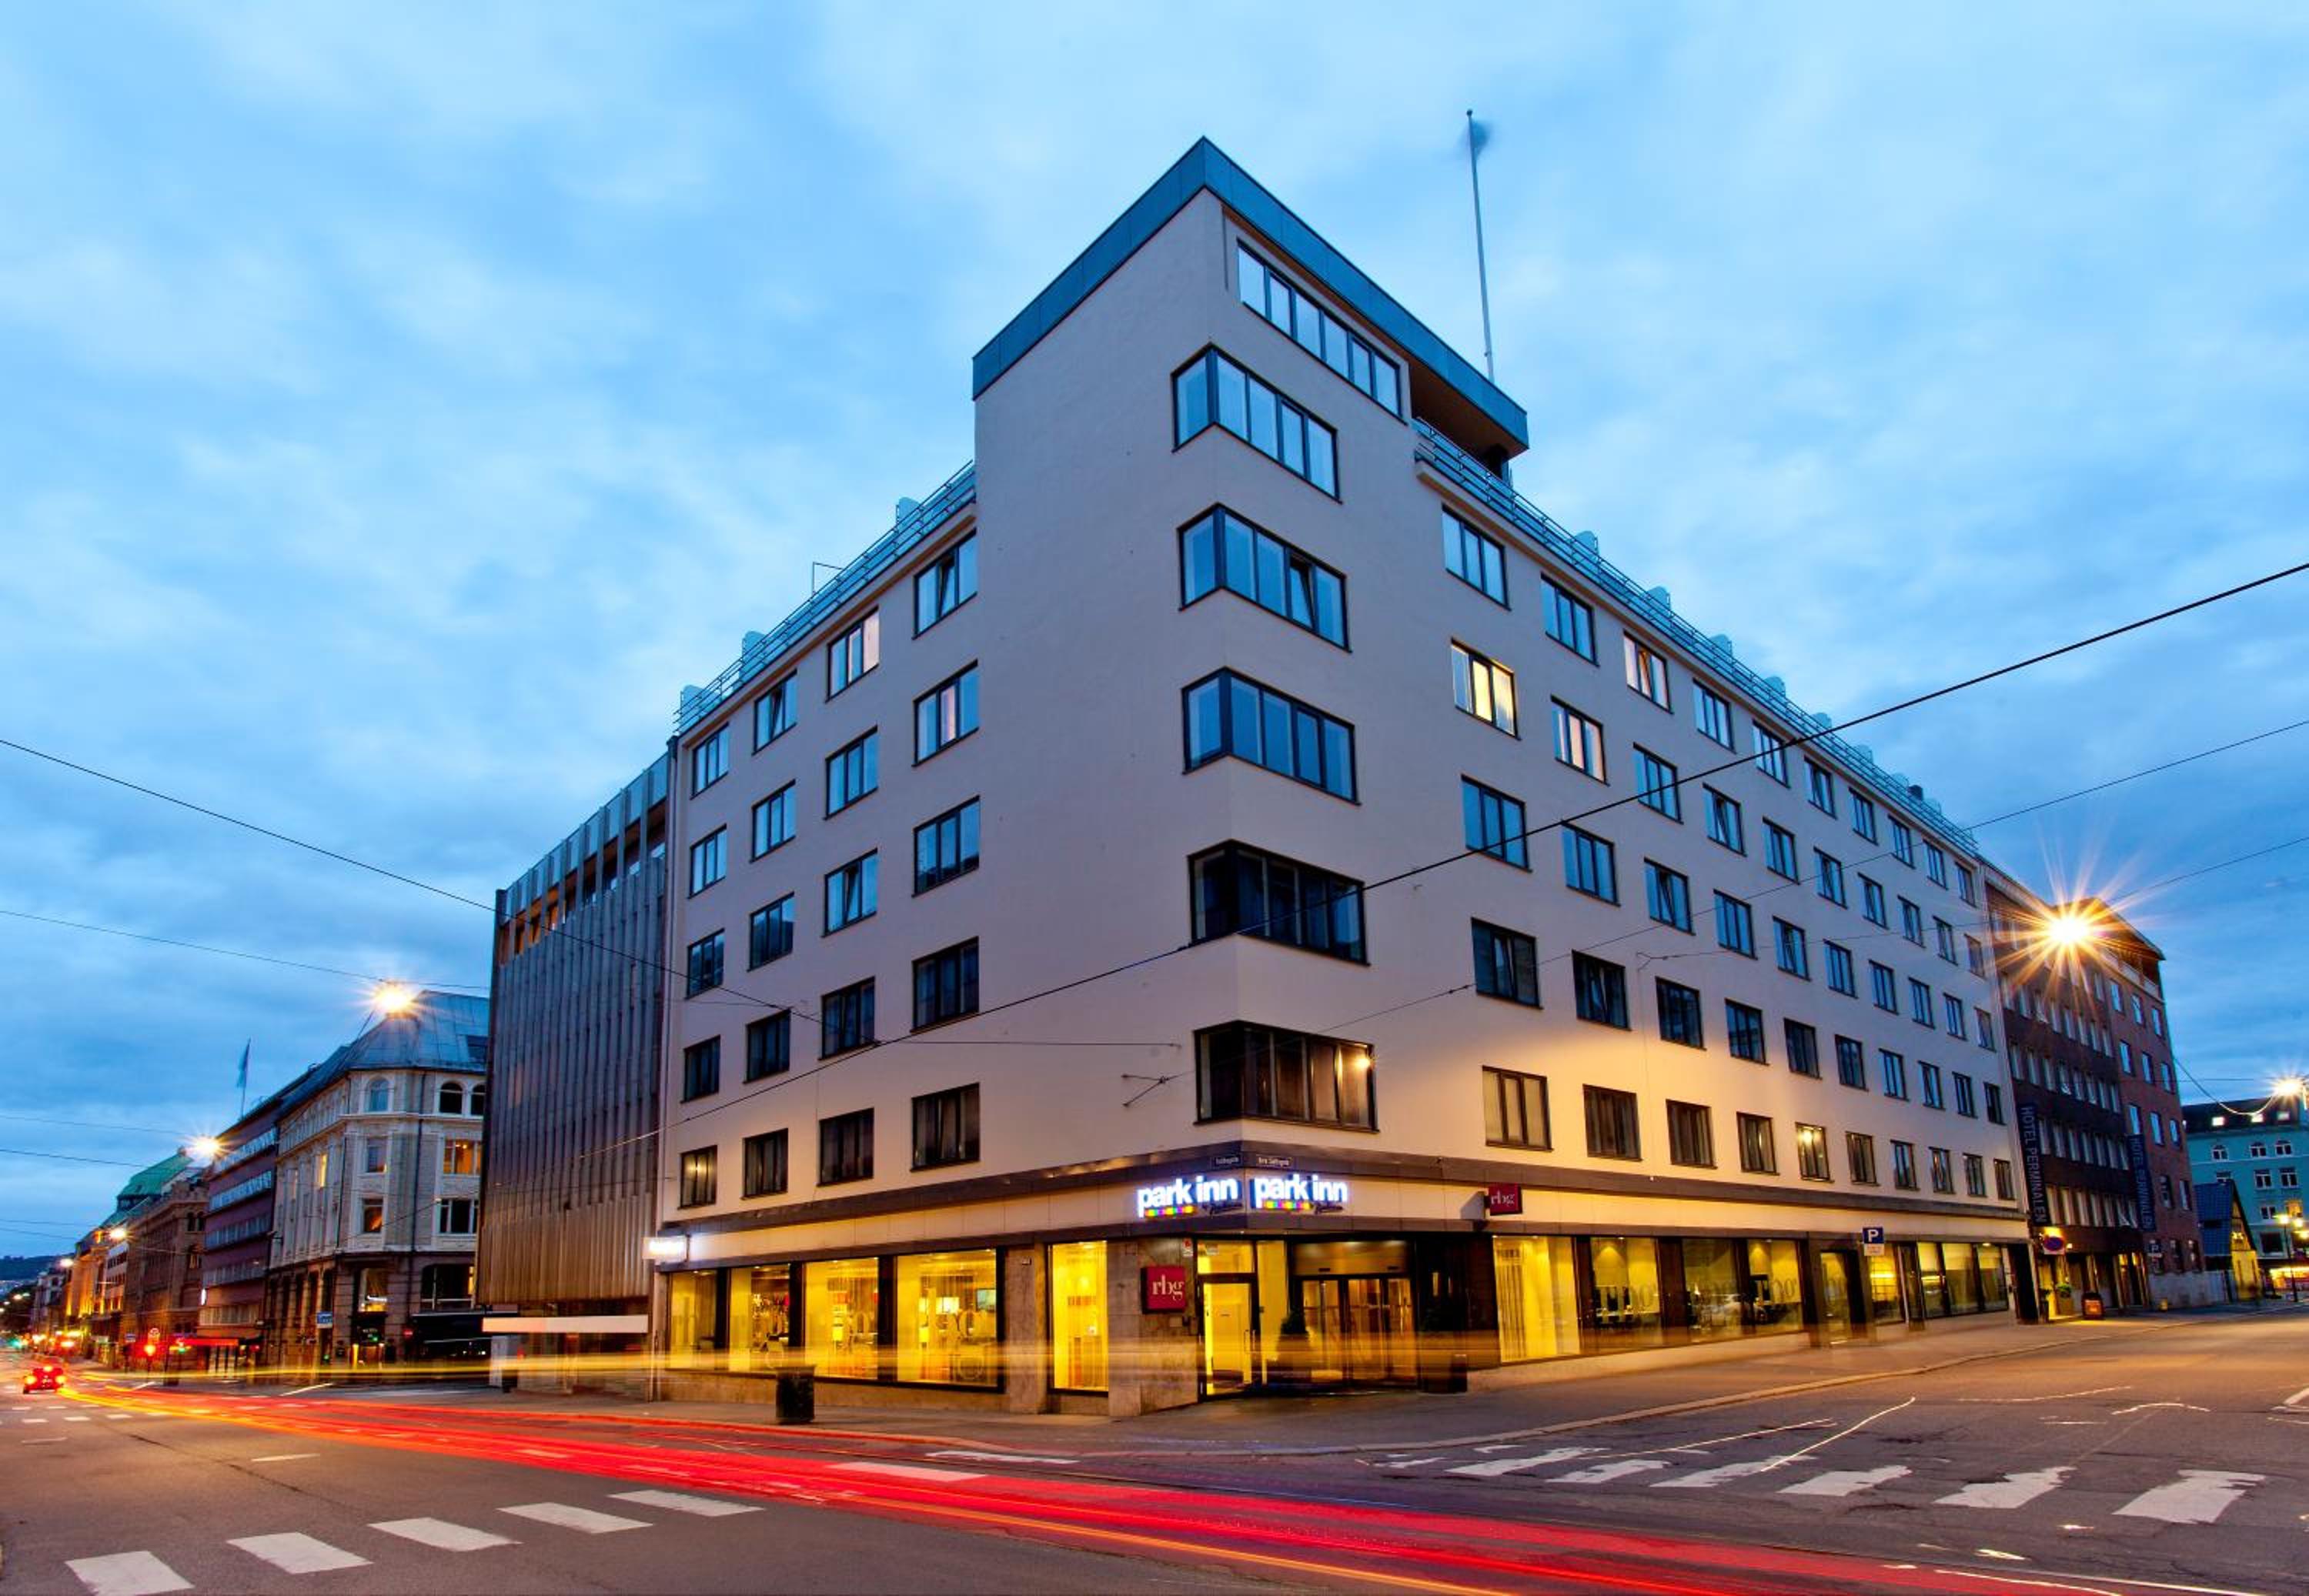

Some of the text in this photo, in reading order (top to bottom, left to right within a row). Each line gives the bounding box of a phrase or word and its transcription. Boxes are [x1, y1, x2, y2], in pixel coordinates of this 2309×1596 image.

[2020, 1106, 2047, 1223] HOTEL PERMINALEN
[1137, 1175, 1238, 1218] park inn
[1254, 1174, 1309, 1209] park
[1312, 1174, 1348, 1202] inn
[1867, 1229, 1879, 1243] P
[1152, 1274, 1185, 1301] rbg
